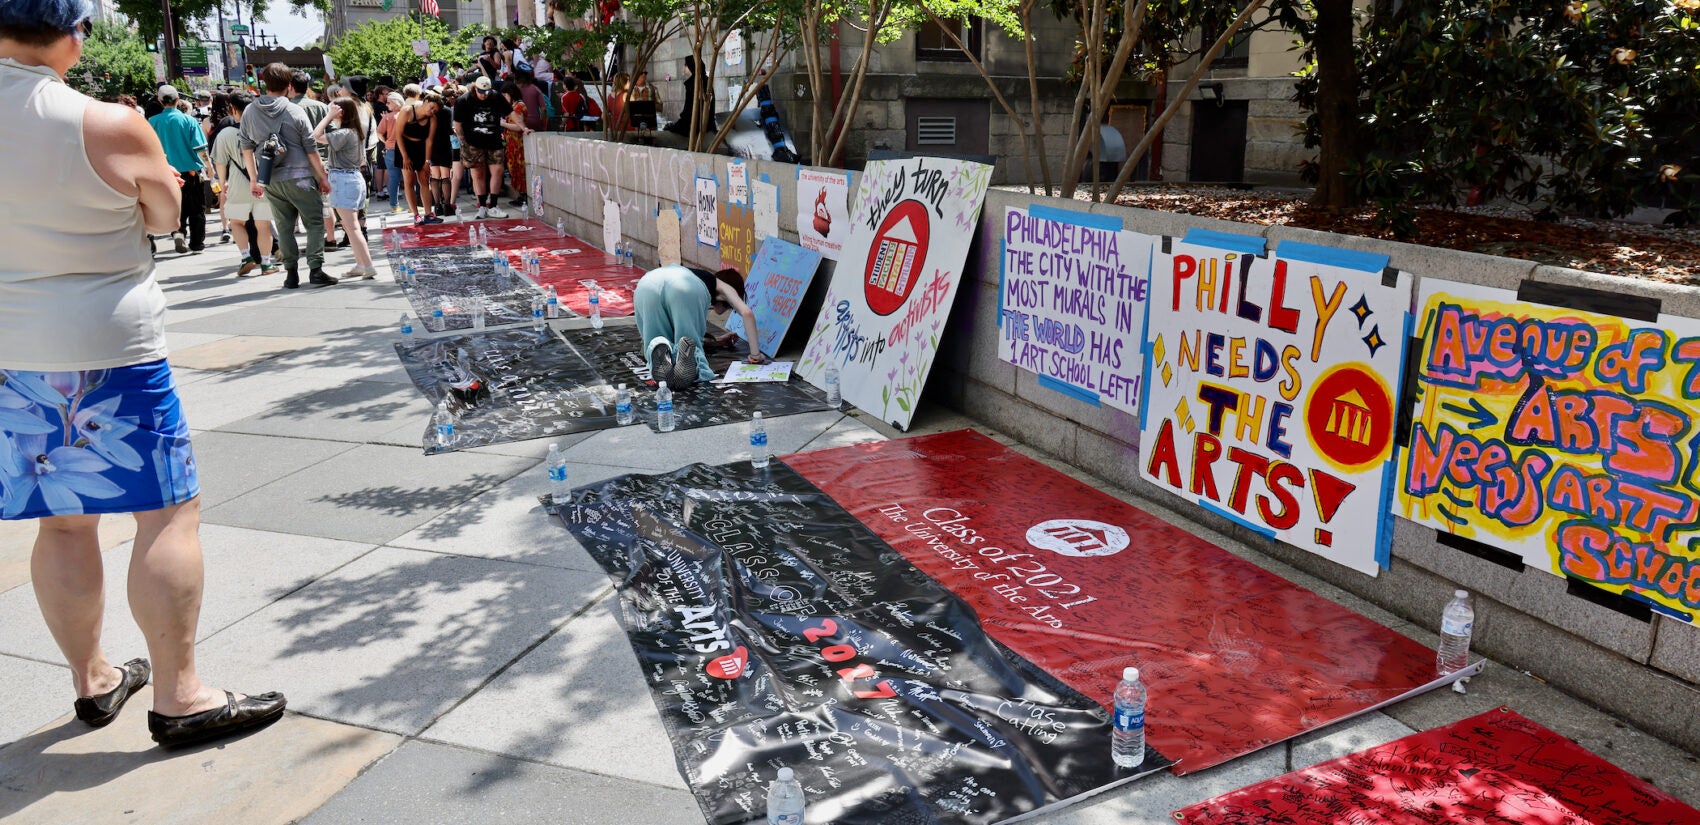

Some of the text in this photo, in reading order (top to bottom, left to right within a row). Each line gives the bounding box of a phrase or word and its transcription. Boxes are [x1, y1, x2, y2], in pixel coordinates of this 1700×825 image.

[615, 146, 663, 220] CITY
[870, 240, 888, 284] STUDENT
[879, 242, 896, 287] FACULTY
[888, 246, 904, 288] STAFF
[1007, 248, 1148, 302] THE CITY WITH THE
[860, 331, 886, 372] into
[888, 268, 951, 348] activists
[1007, 278, 1132, 334] MOST MURALS IN
[1002, 310, 1030, 342] THE
[1090, 331, 1124, 369] HAS
[1178, 330, 1302, 401] NEEDS
[1010, 340, 1140, 406] 1 ART SCHOOL LEFT!
[1198, 381, 1294, 458] THE
[1505, 384, 1692, 486] ARTS
[1147, 418, 1357, 546] ARTS!
[1547, 465, 1692, 542] ART
[667, 550, 706, 600] UNIVERSITY
[704, 519, 780, 580] CLASS
[880, 502, 908, 522] The
[904, 522, 980, 570] University
[974, 572, 1010, 581] of
[992, 584, 1028, 604] the
[922, 507, 1098, 610] Class of 2021
[656, 572, 684, 604] OF THE
[802, 618, 898, 699] 2017
[997, 701, 1058, 745] Catling
[949, 791, 970, 804] only
[962, 786, 980, 796] and
[980, 787, 996, 797] one
